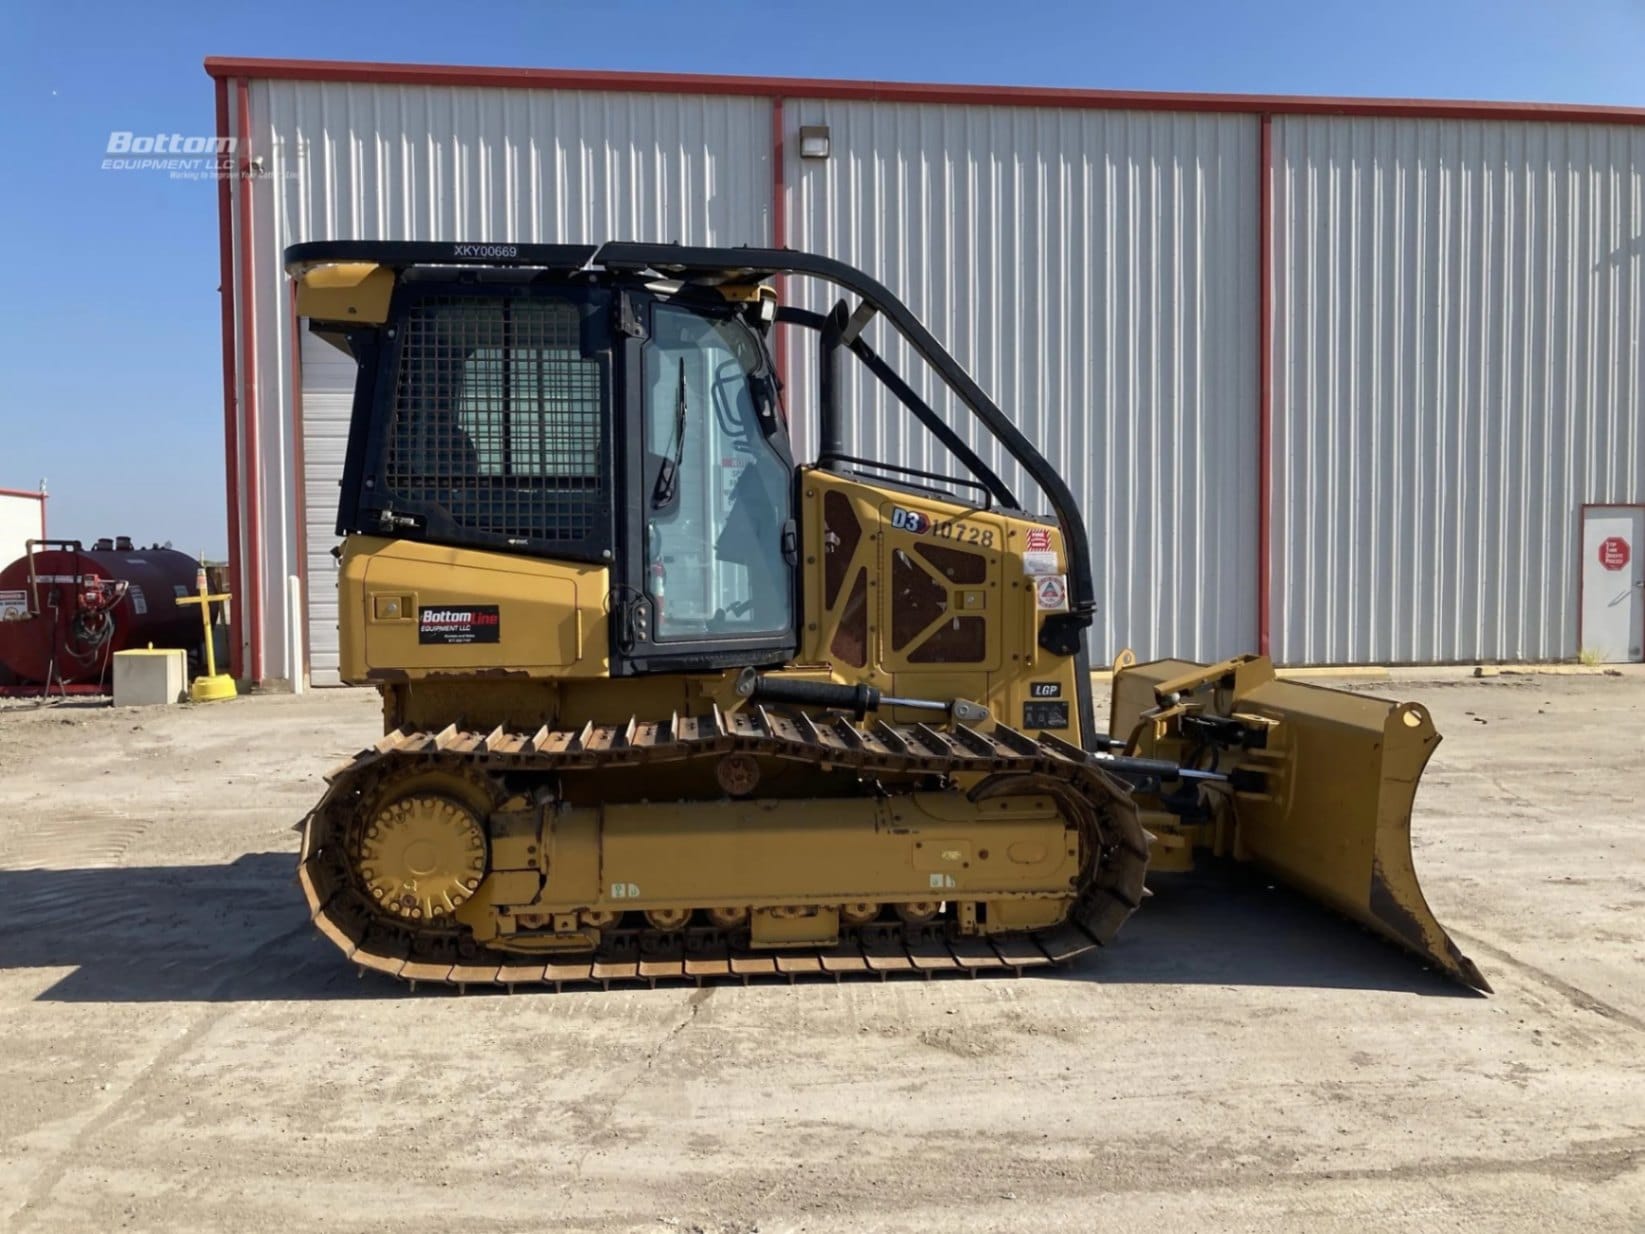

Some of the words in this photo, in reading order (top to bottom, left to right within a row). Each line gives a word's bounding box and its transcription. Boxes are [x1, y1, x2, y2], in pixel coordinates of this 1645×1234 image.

[454, 245, 517, 257] XKY00669
[892, 506, 921, 533] D3
[932, 519, 994, 548] 10728
[1035, 685, 1058, 696] LGP
